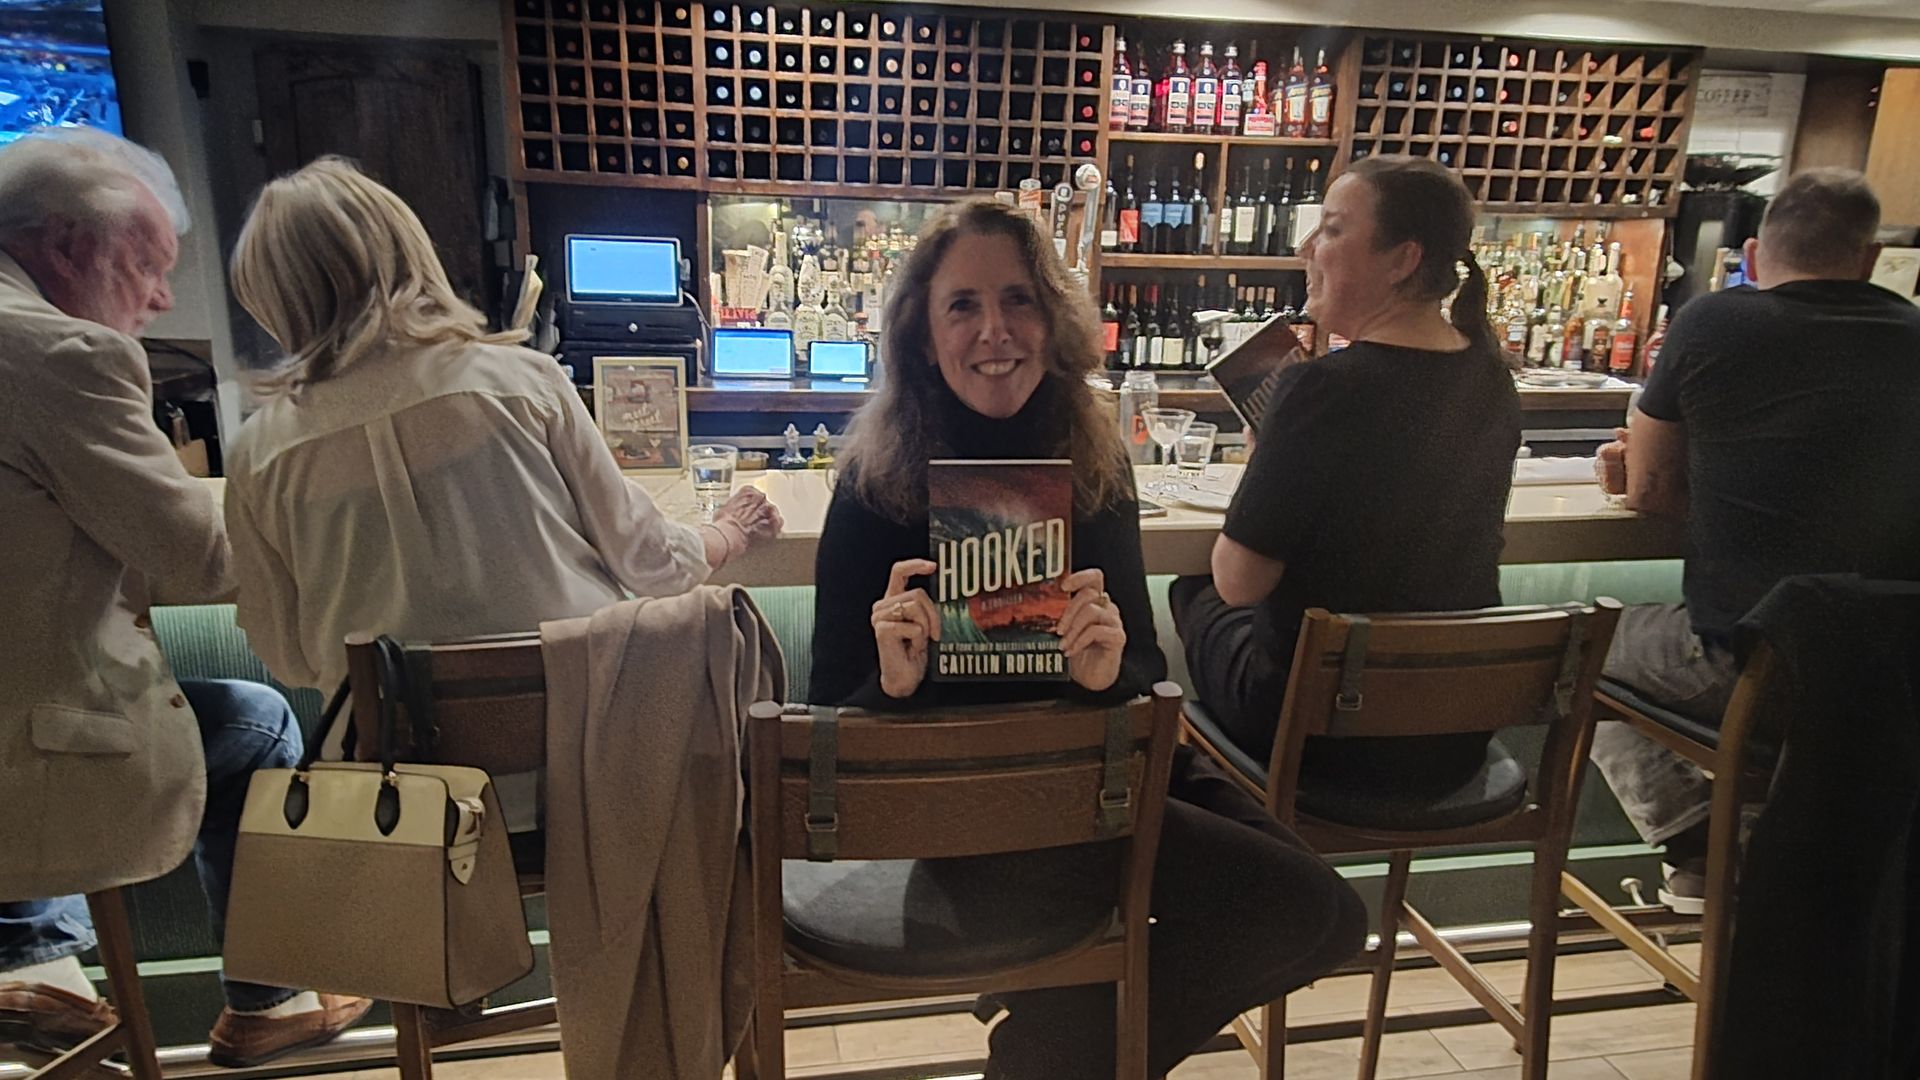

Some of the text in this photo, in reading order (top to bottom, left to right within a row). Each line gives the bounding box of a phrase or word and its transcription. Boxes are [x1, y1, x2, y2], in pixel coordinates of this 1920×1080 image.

[938, 518, 1065, 603] HOOKED
[939, 653, 1063, 675] CAITLIN ROTHER
